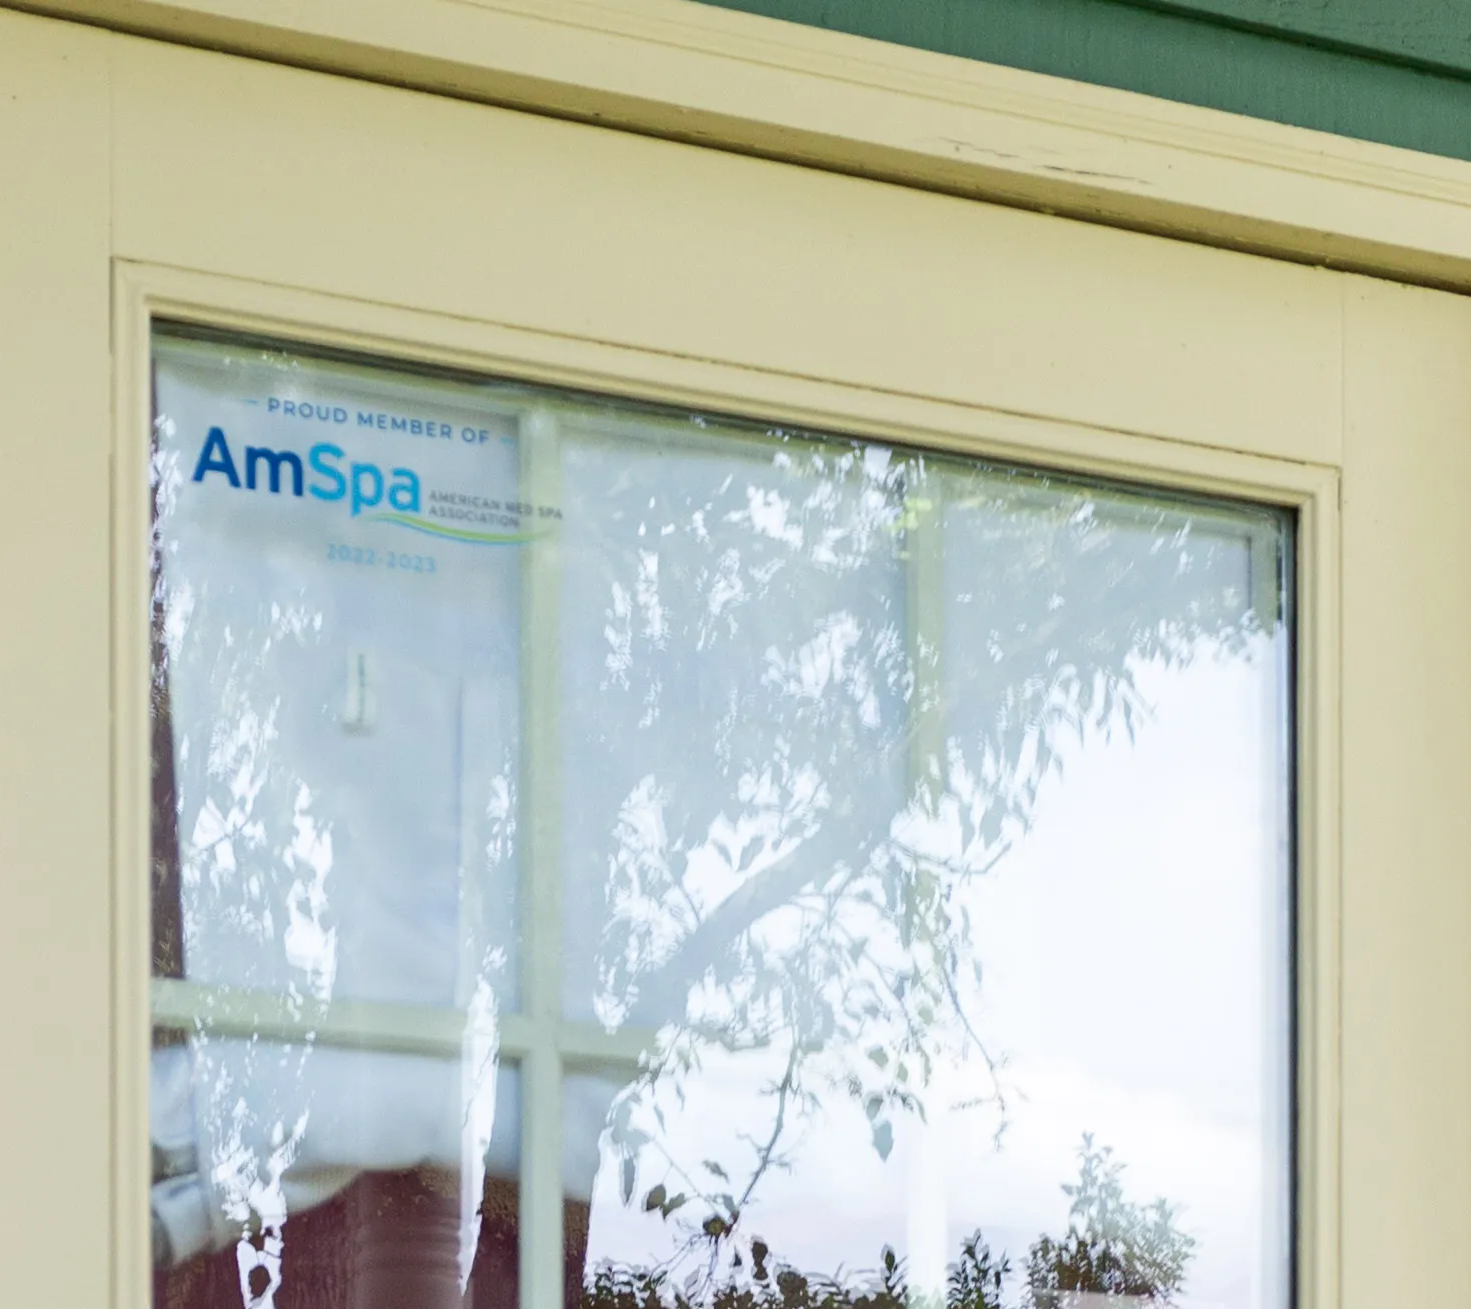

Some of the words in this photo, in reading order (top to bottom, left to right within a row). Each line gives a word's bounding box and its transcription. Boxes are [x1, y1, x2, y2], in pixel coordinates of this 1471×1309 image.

[267, 397, 348, 423] PROUD
[357, 411, 453, 439] MEMBER
[461, 427, 490, 444] OF
[192, 426, 421, 517] AmSpa
[429, 491, 500, 511] AMERICAN
[537, 505, 563, 520] SPA
[429, 505, 520, 528] ASSOCIATION
